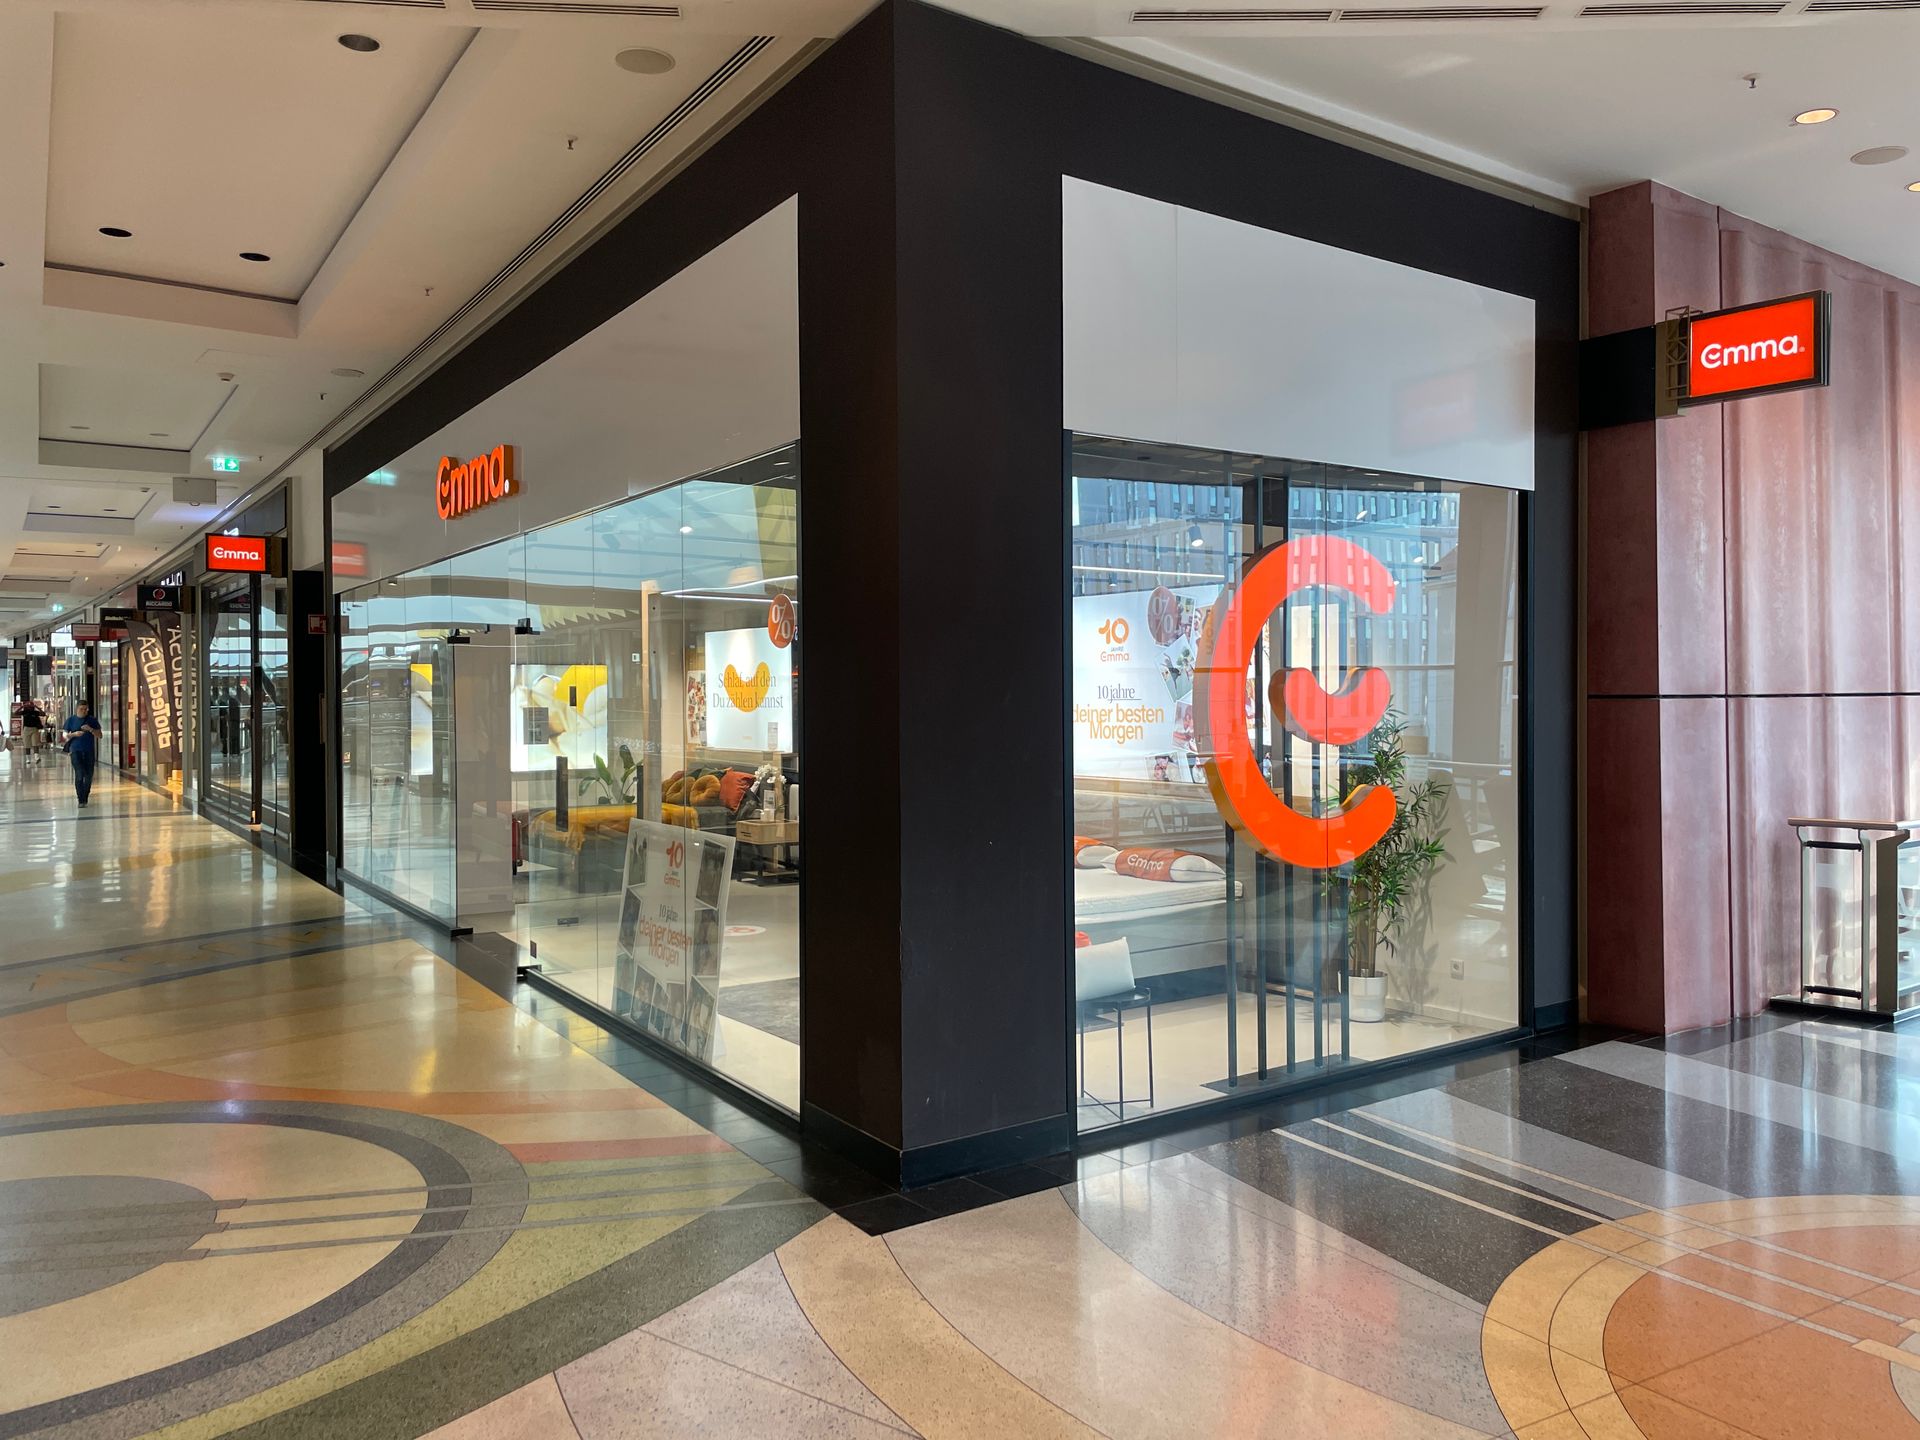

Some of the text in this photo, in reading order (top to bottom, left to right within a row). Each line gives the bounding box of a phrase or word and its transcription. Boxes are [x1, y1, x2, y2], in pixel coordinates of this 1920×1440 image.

[1098, 618, 1130, 645] 10
[760, 670, 776, 688] den
[712, 692, 784, 708] Du zählen kannst
[1097, 684, 1135, 703] 10 jahre
[1116, 703, 1165, 723] besten
[1089, 719, 1144, 744] Morgen
